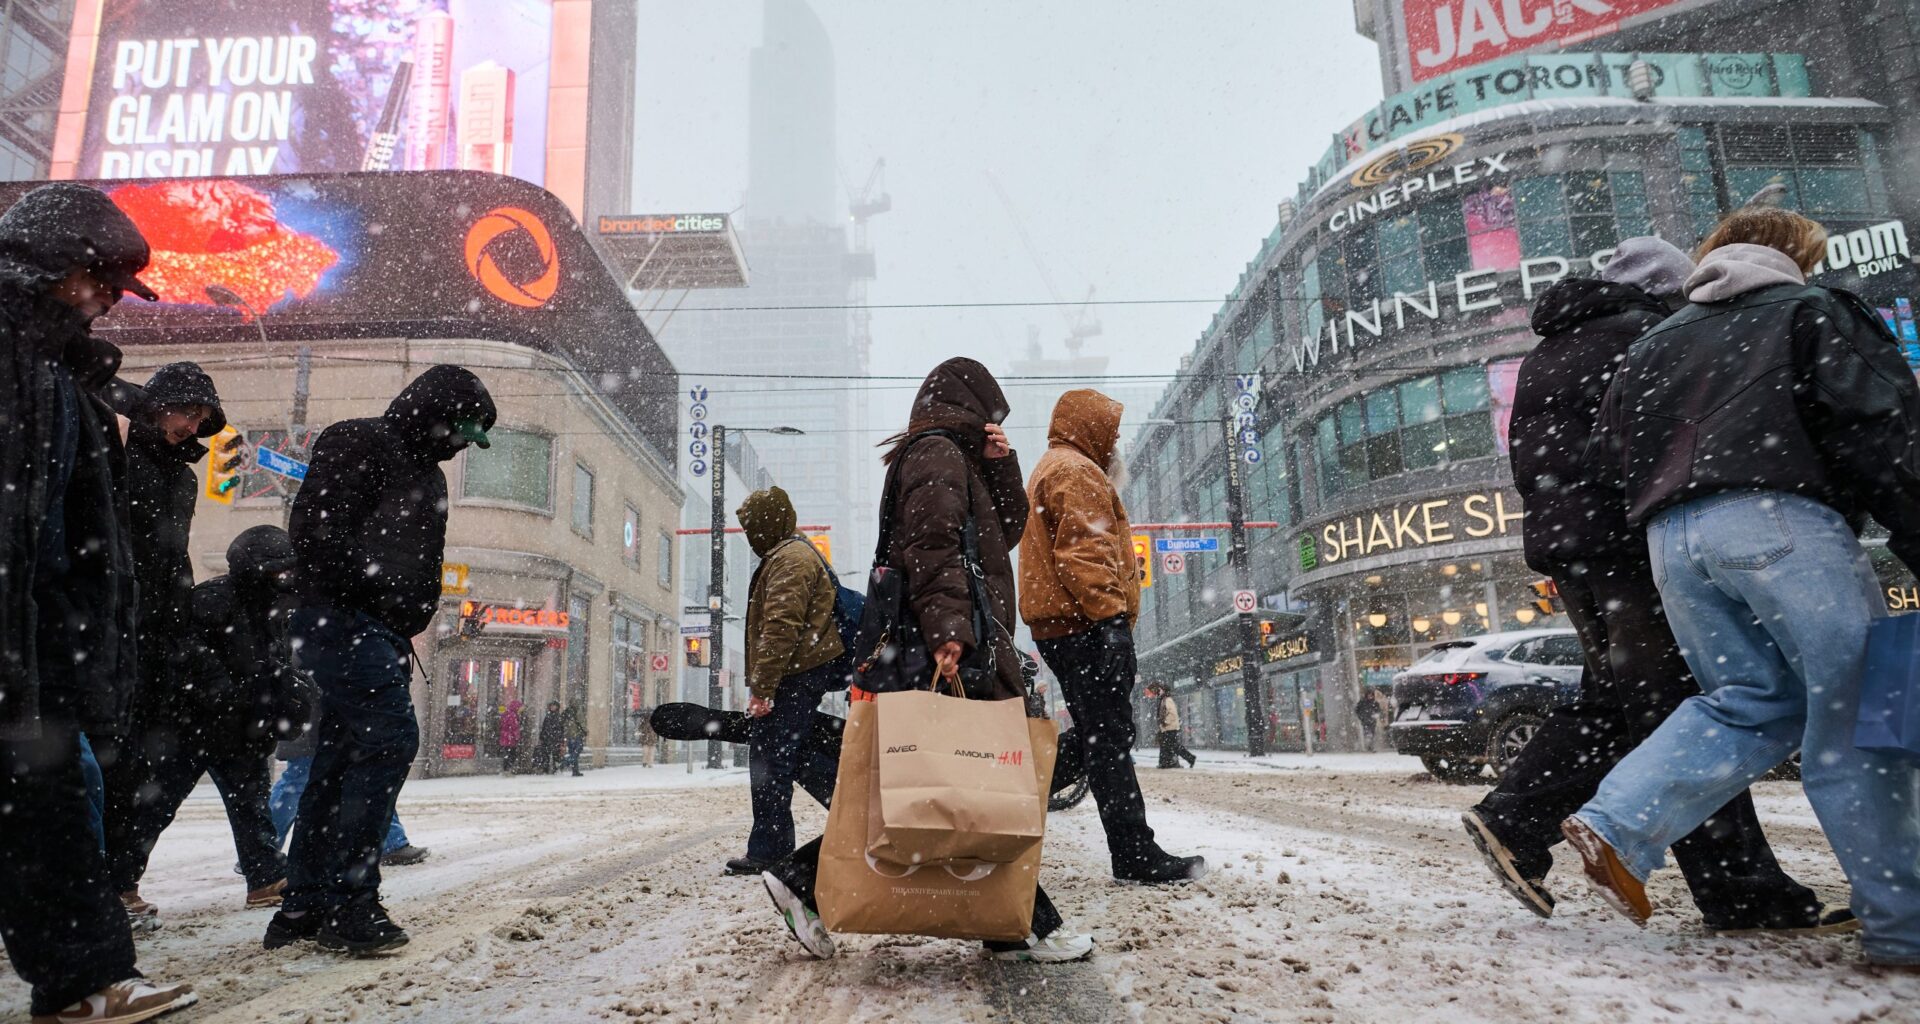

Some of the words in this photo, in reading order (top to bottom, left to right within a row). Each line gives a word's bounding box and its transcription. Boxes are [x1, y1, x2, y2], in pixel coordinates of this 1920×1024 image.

[1416, 0, 1614, 67] JAC
[112, 38, 199, 89] PUT
[204, 36, 317, 86] YOUR
[106, 92, 226, 145] GLAM
[230, 90, 292, 142] ON
[1368, 82, 1458, 141] CAFE
[1329, 152, 1510, 232] CINEPLEX
[600, 215, 723, 232] brandedcities
[1857, 255, 1903, 278] BOWL
[1226, 421, 1239, 486] DOWNTOWN
[1167, 540, 1200, 549] Dundas
[1323, 500, 1454, 562] SHAKE
[496, 607, 569, 627] ROGERS
[886, 744, 917, 754] AVEC
[954, 749, 995, 759] AMOUR
